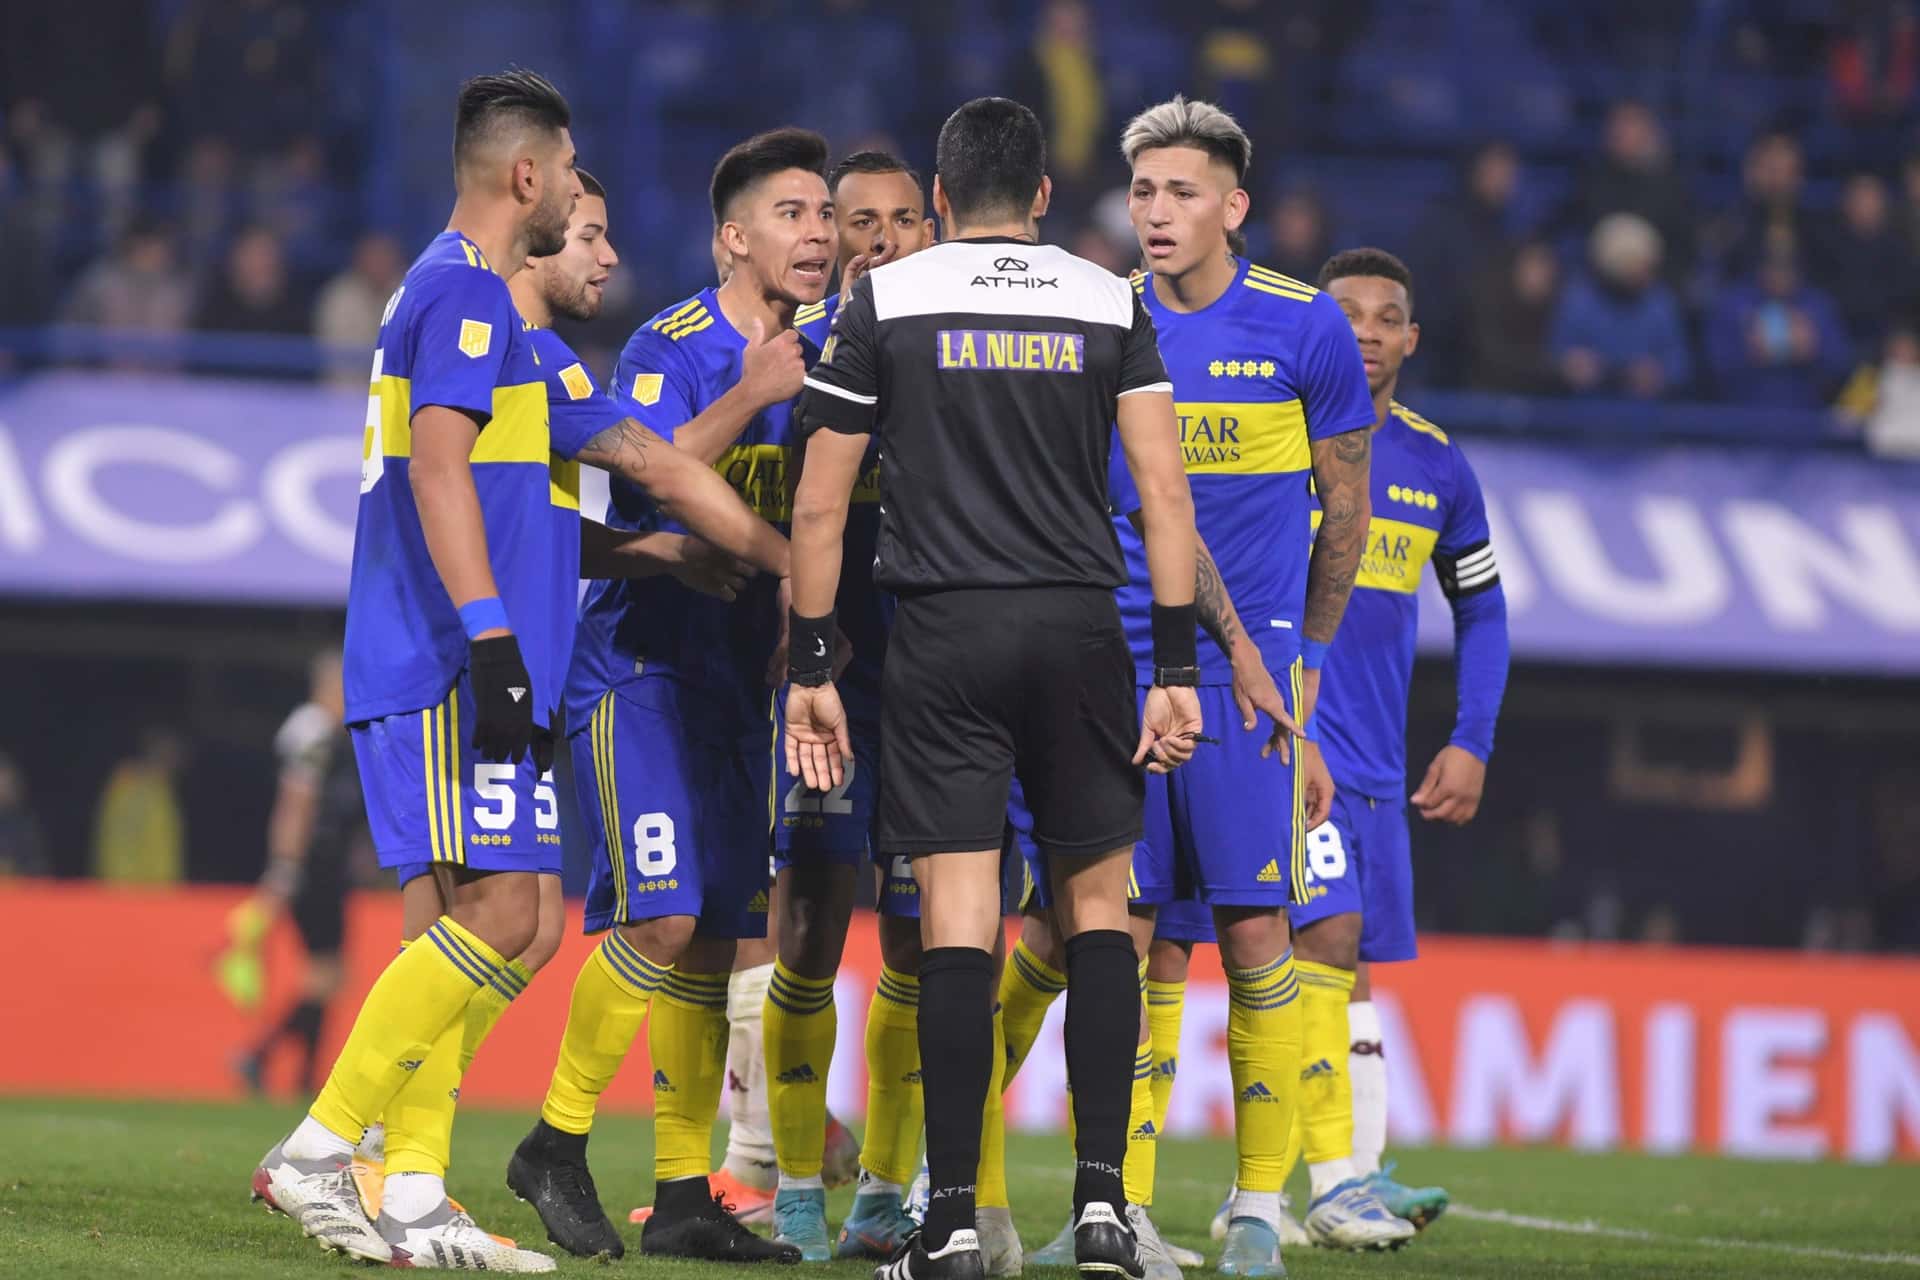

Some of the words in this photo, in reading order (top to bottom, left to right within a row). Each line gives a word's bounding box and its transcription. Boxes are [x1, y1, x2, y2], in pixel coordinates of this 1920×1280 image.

[970, 275, 1059, 288] ATHIX
[942, 333, 978, 368] LA
[986, 333, 1079, 371] NUEVA
[473, 763, 516, 830] 5
[633, 812, 677, 877] 8
[1305, 820, 1347, 882] 8
[933, 1184, 977, 1199] ATHI
